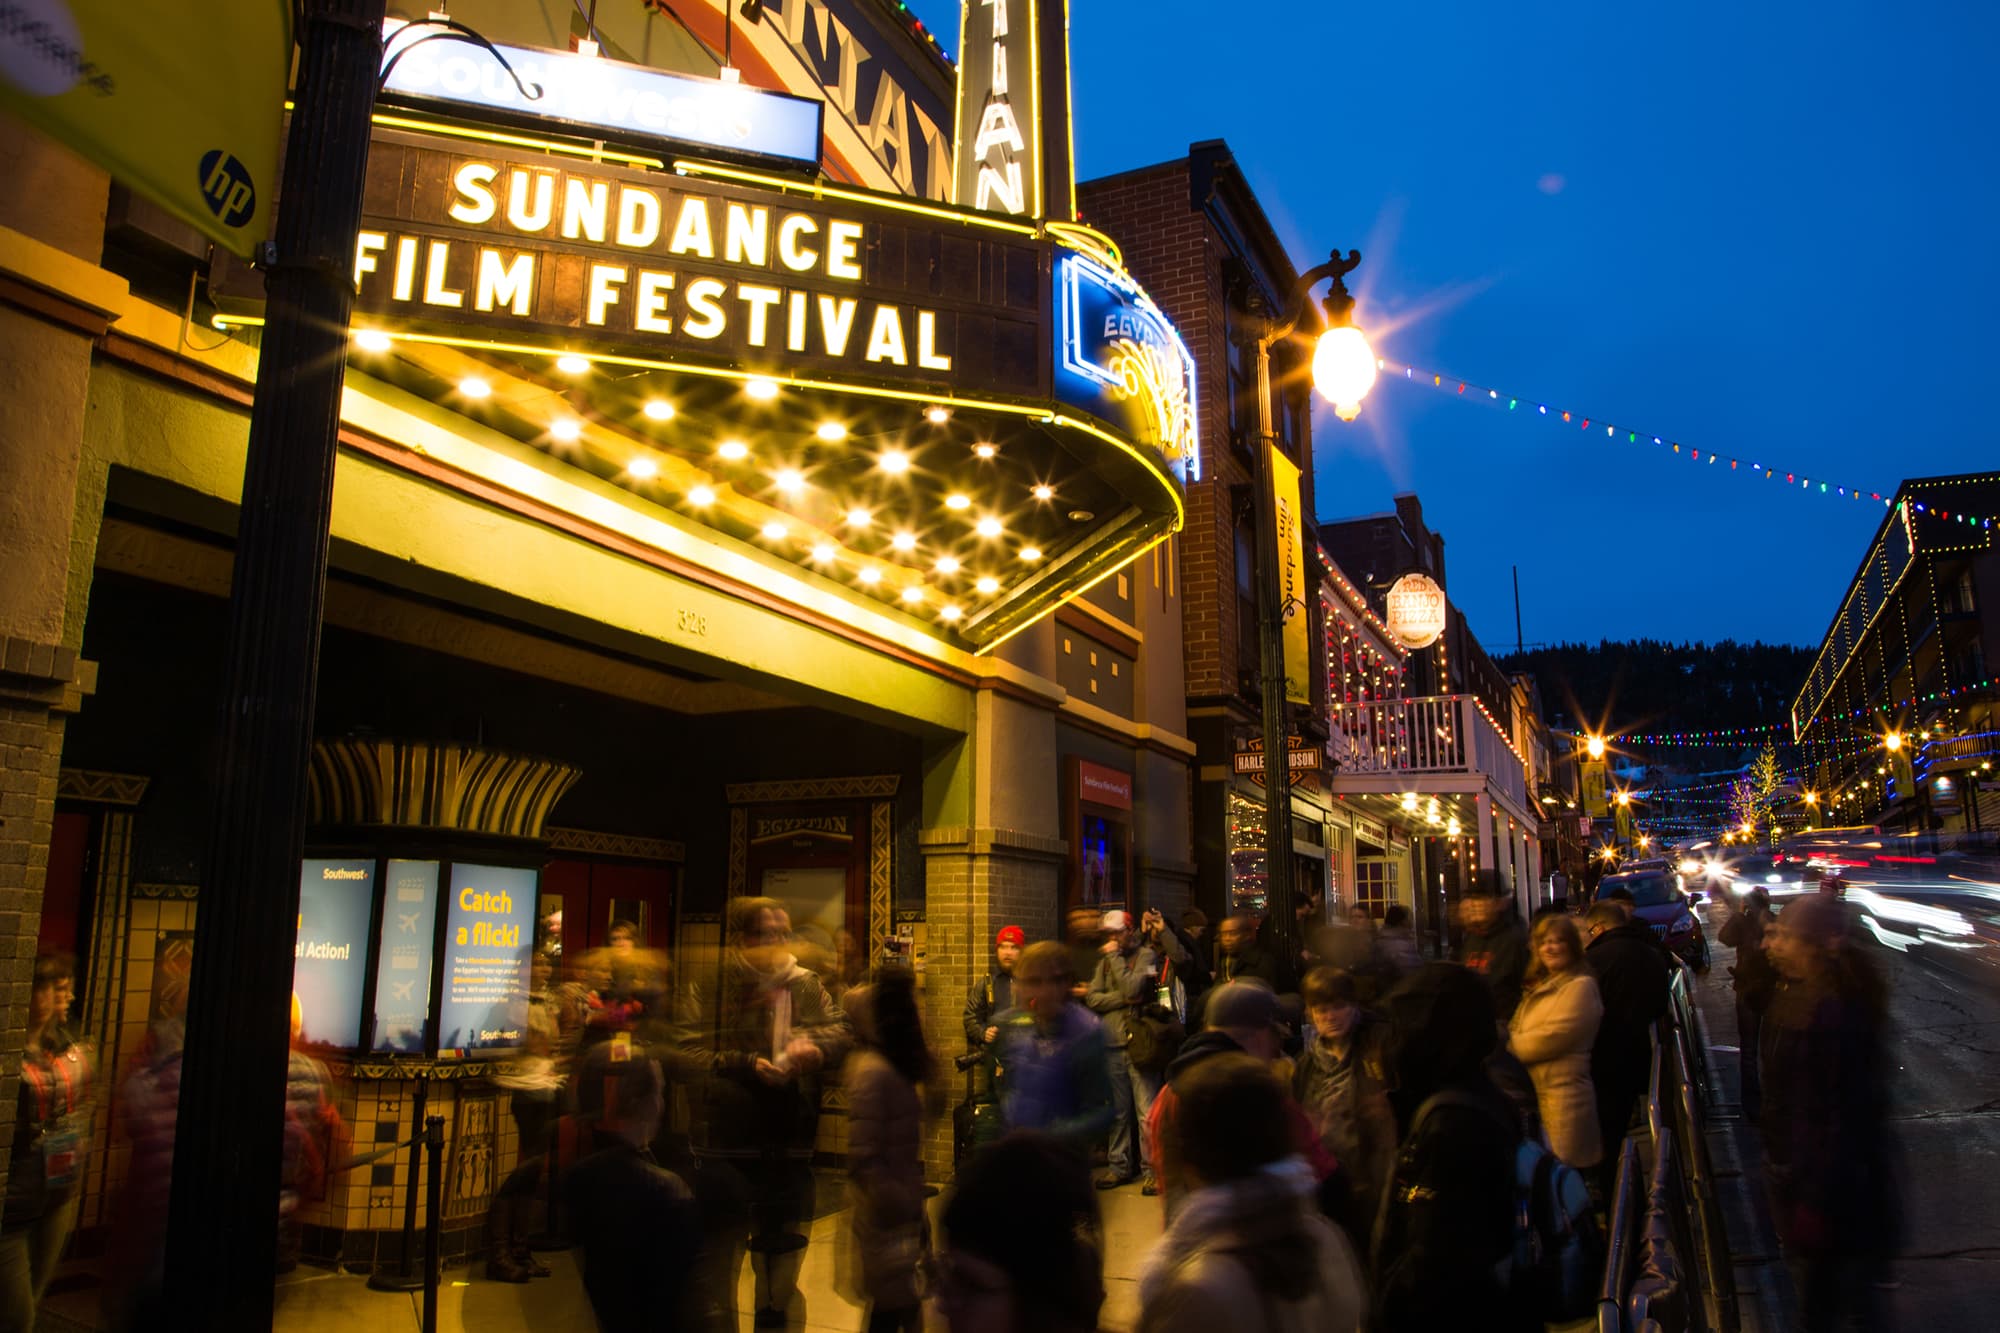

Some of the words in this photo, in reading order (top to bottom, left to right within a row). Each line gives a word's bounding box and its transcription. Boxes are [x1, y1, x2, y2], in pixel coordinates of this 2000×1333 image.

[198, 149, 256, 228] hp
[447, 160, 864, 280] SUNDANCE
[354, 229, 536, 318] FILM
[585, 261, 952, 371] FESTIVAL
[1279, 496, 1288, 538] Film
[1284, 515, 1296, 617] Sundance
[1402, 578, 1428, 592] RED
[678, 608, 706, 636] 328
[1391, 609, 1440, 625] PIZZA
[757, 816, 847, 834] EGYPTIAN
[323, 868, 364, 881] Southwest
[459, 887, 512, 914] Catch
[456, 927, 468, 946] a
[473, 921, 520, 947] flick!
[305, 941, 350, 960] Action!
